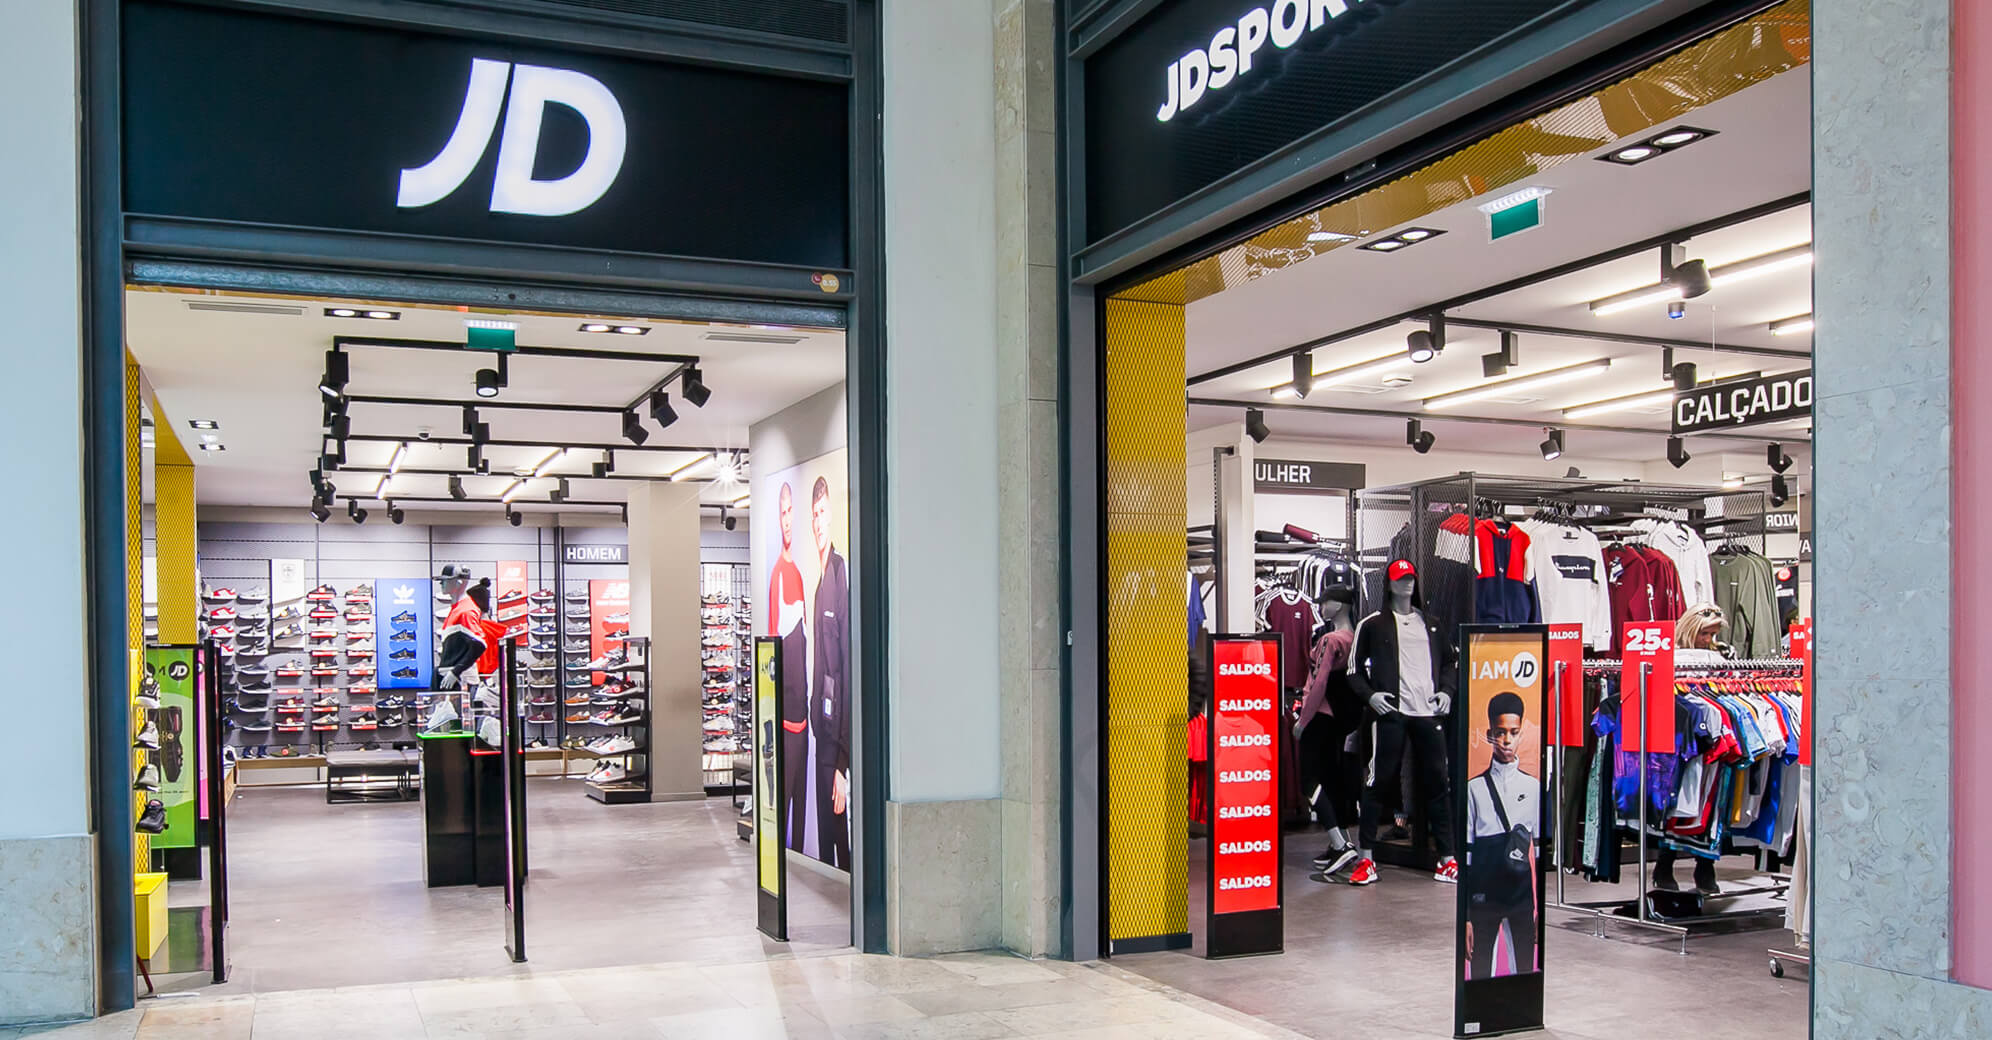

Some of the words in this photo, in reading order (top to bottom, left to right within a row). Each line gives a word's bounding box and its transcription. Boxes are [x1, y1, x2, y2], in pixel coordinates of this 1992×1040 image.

[397, 57, 627, 217] JD
[1677, 376, 1812, 426] CALÇADO
[566, 547, 621, 561] HOMEM
[170, 664, 189, 677] JD
[1219, 663, 1272, 676] SALDOS
[1472, 661, 1477, 680] I
[1479, 661, 1509, 680] AM
[1514, 660, 1534, 678] JD
[1219, 698, 1272, 711] SALDOS
[1219, 734, 1272, 747] SALDOS
[1219, 769, 1272, 782] SALDOS
[1219, 805, 1272, 818] SALDOS
[1219, 840, 1272, 853] SALDOS
[1219, 875, 1272, 888] SALDOS
